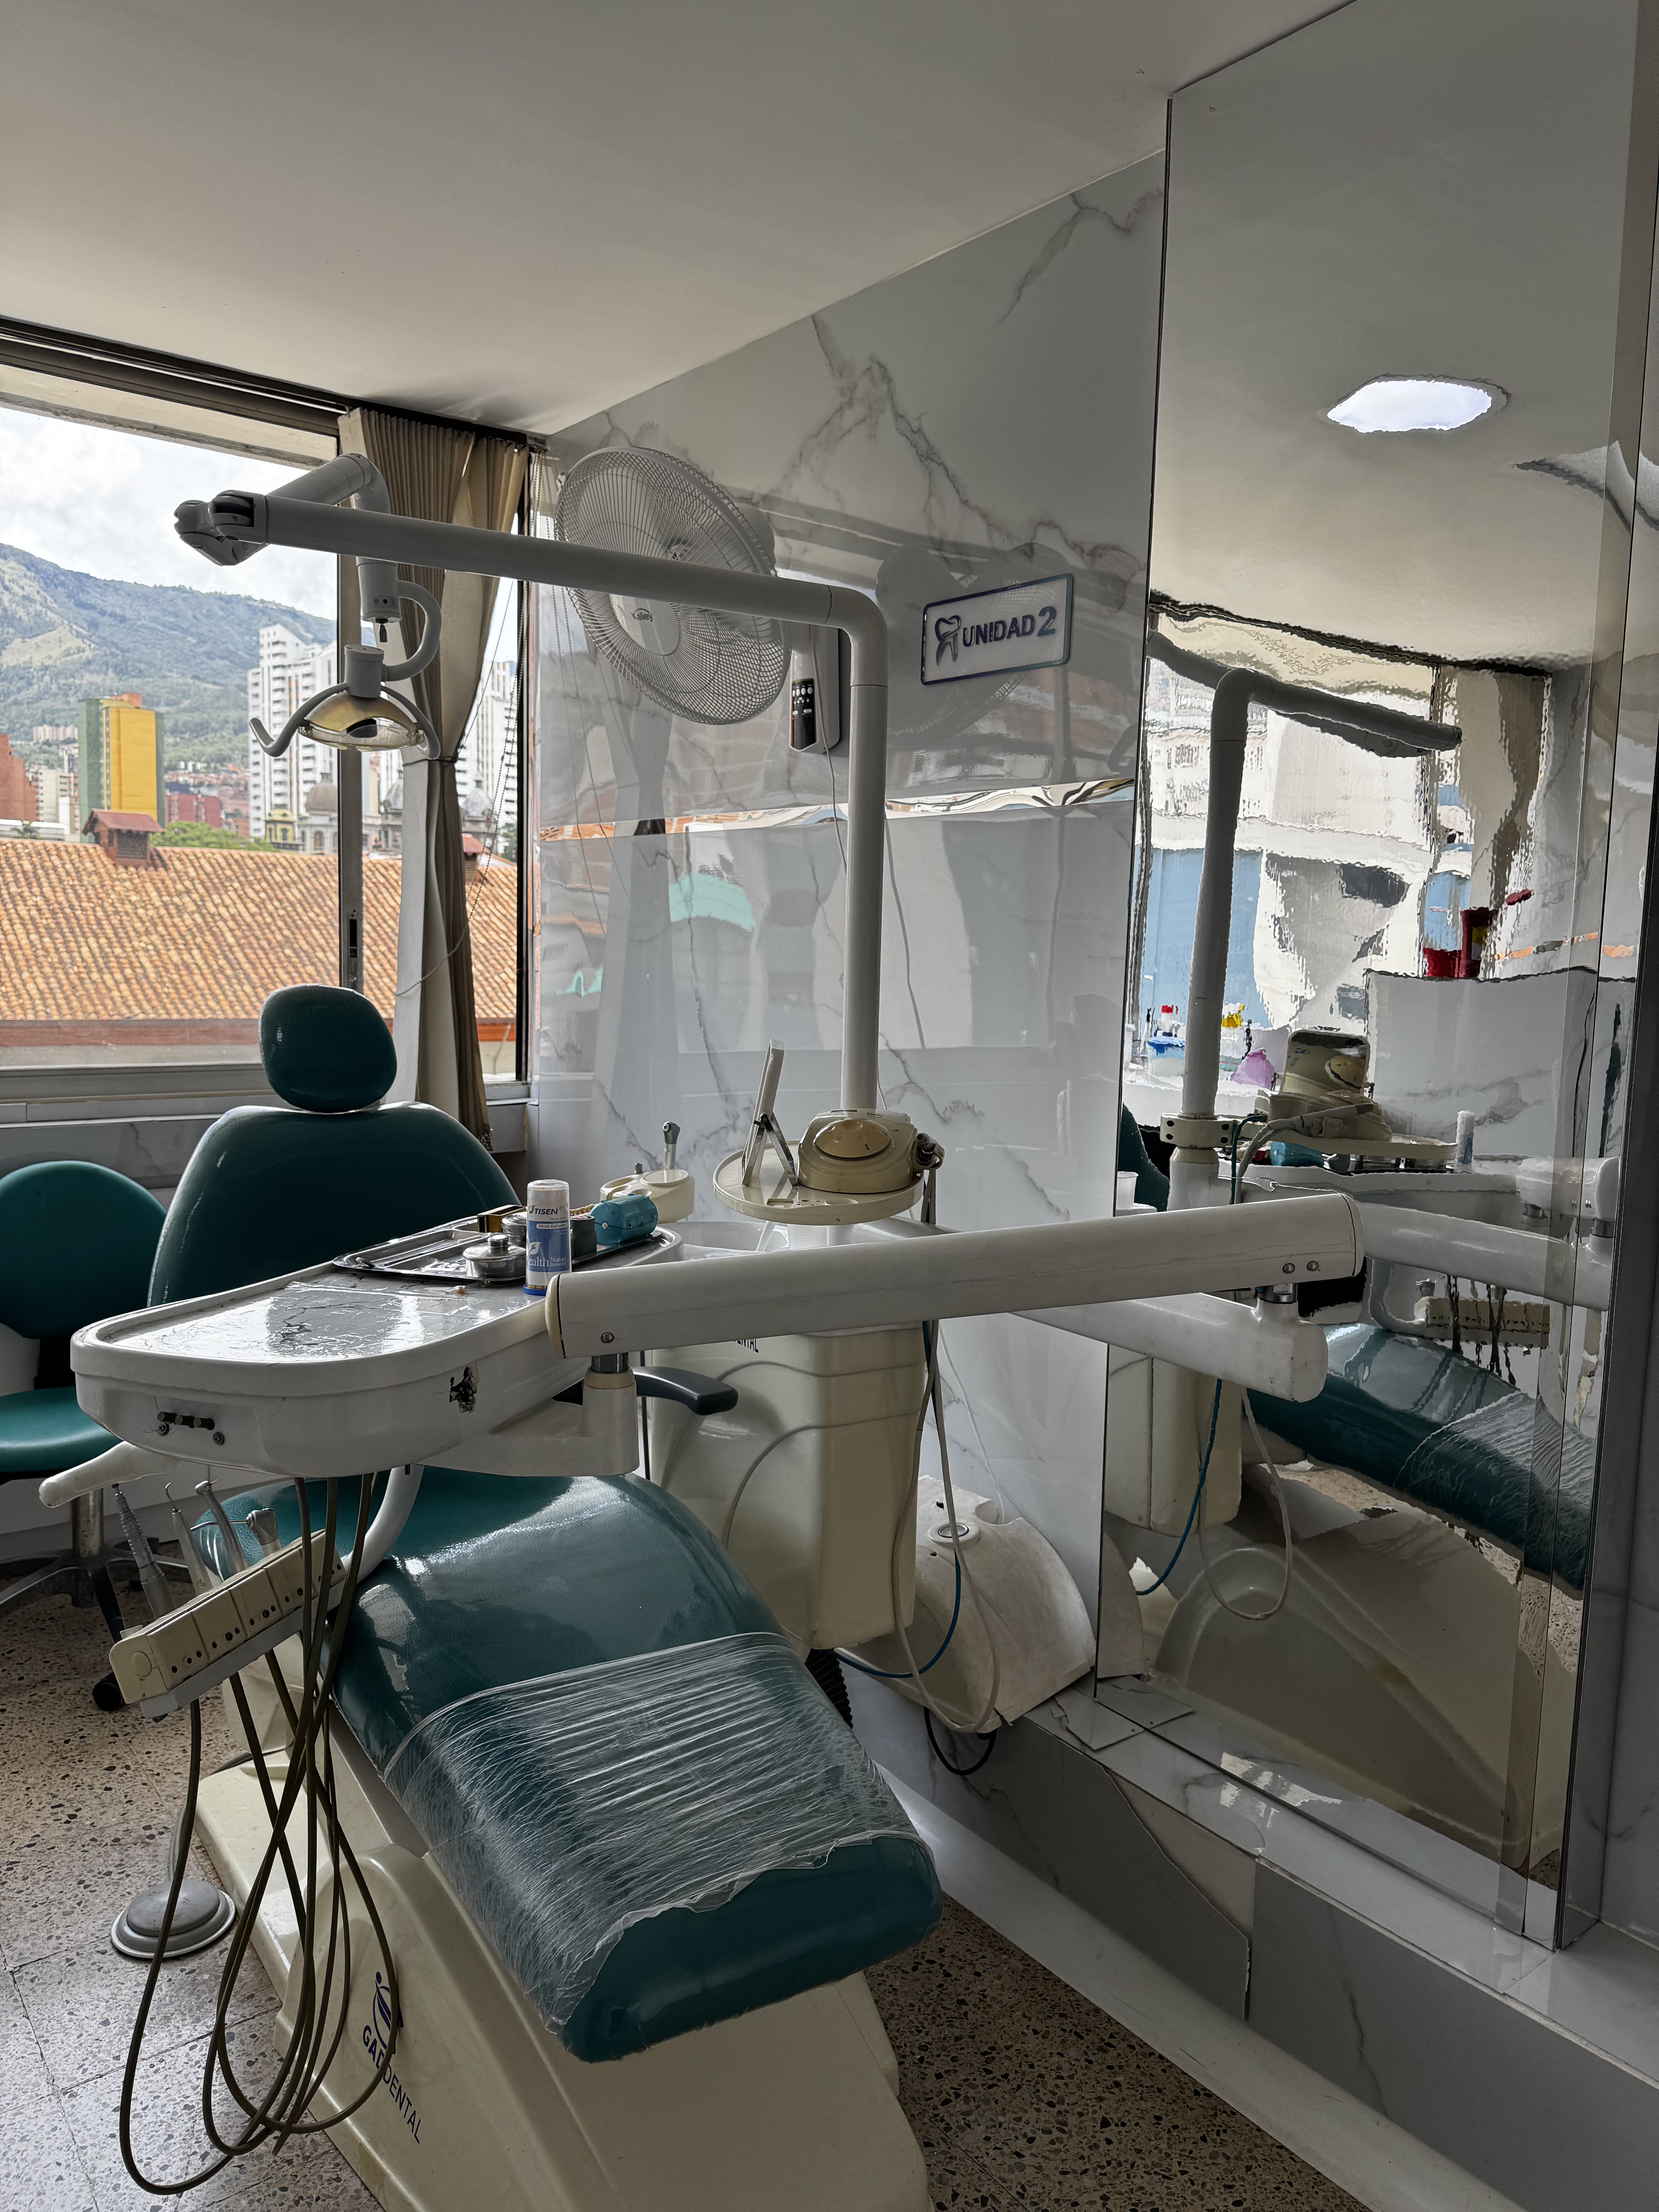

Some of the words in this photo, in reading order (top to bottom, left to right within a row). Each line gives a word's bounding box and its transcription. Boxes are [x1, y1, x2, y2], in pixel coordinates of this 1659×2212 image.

[962, 615, 1034, 647] UNIDAD
[1037, 606, 1057, 636] 2
[529, 1257, 549, 1267] ealth
